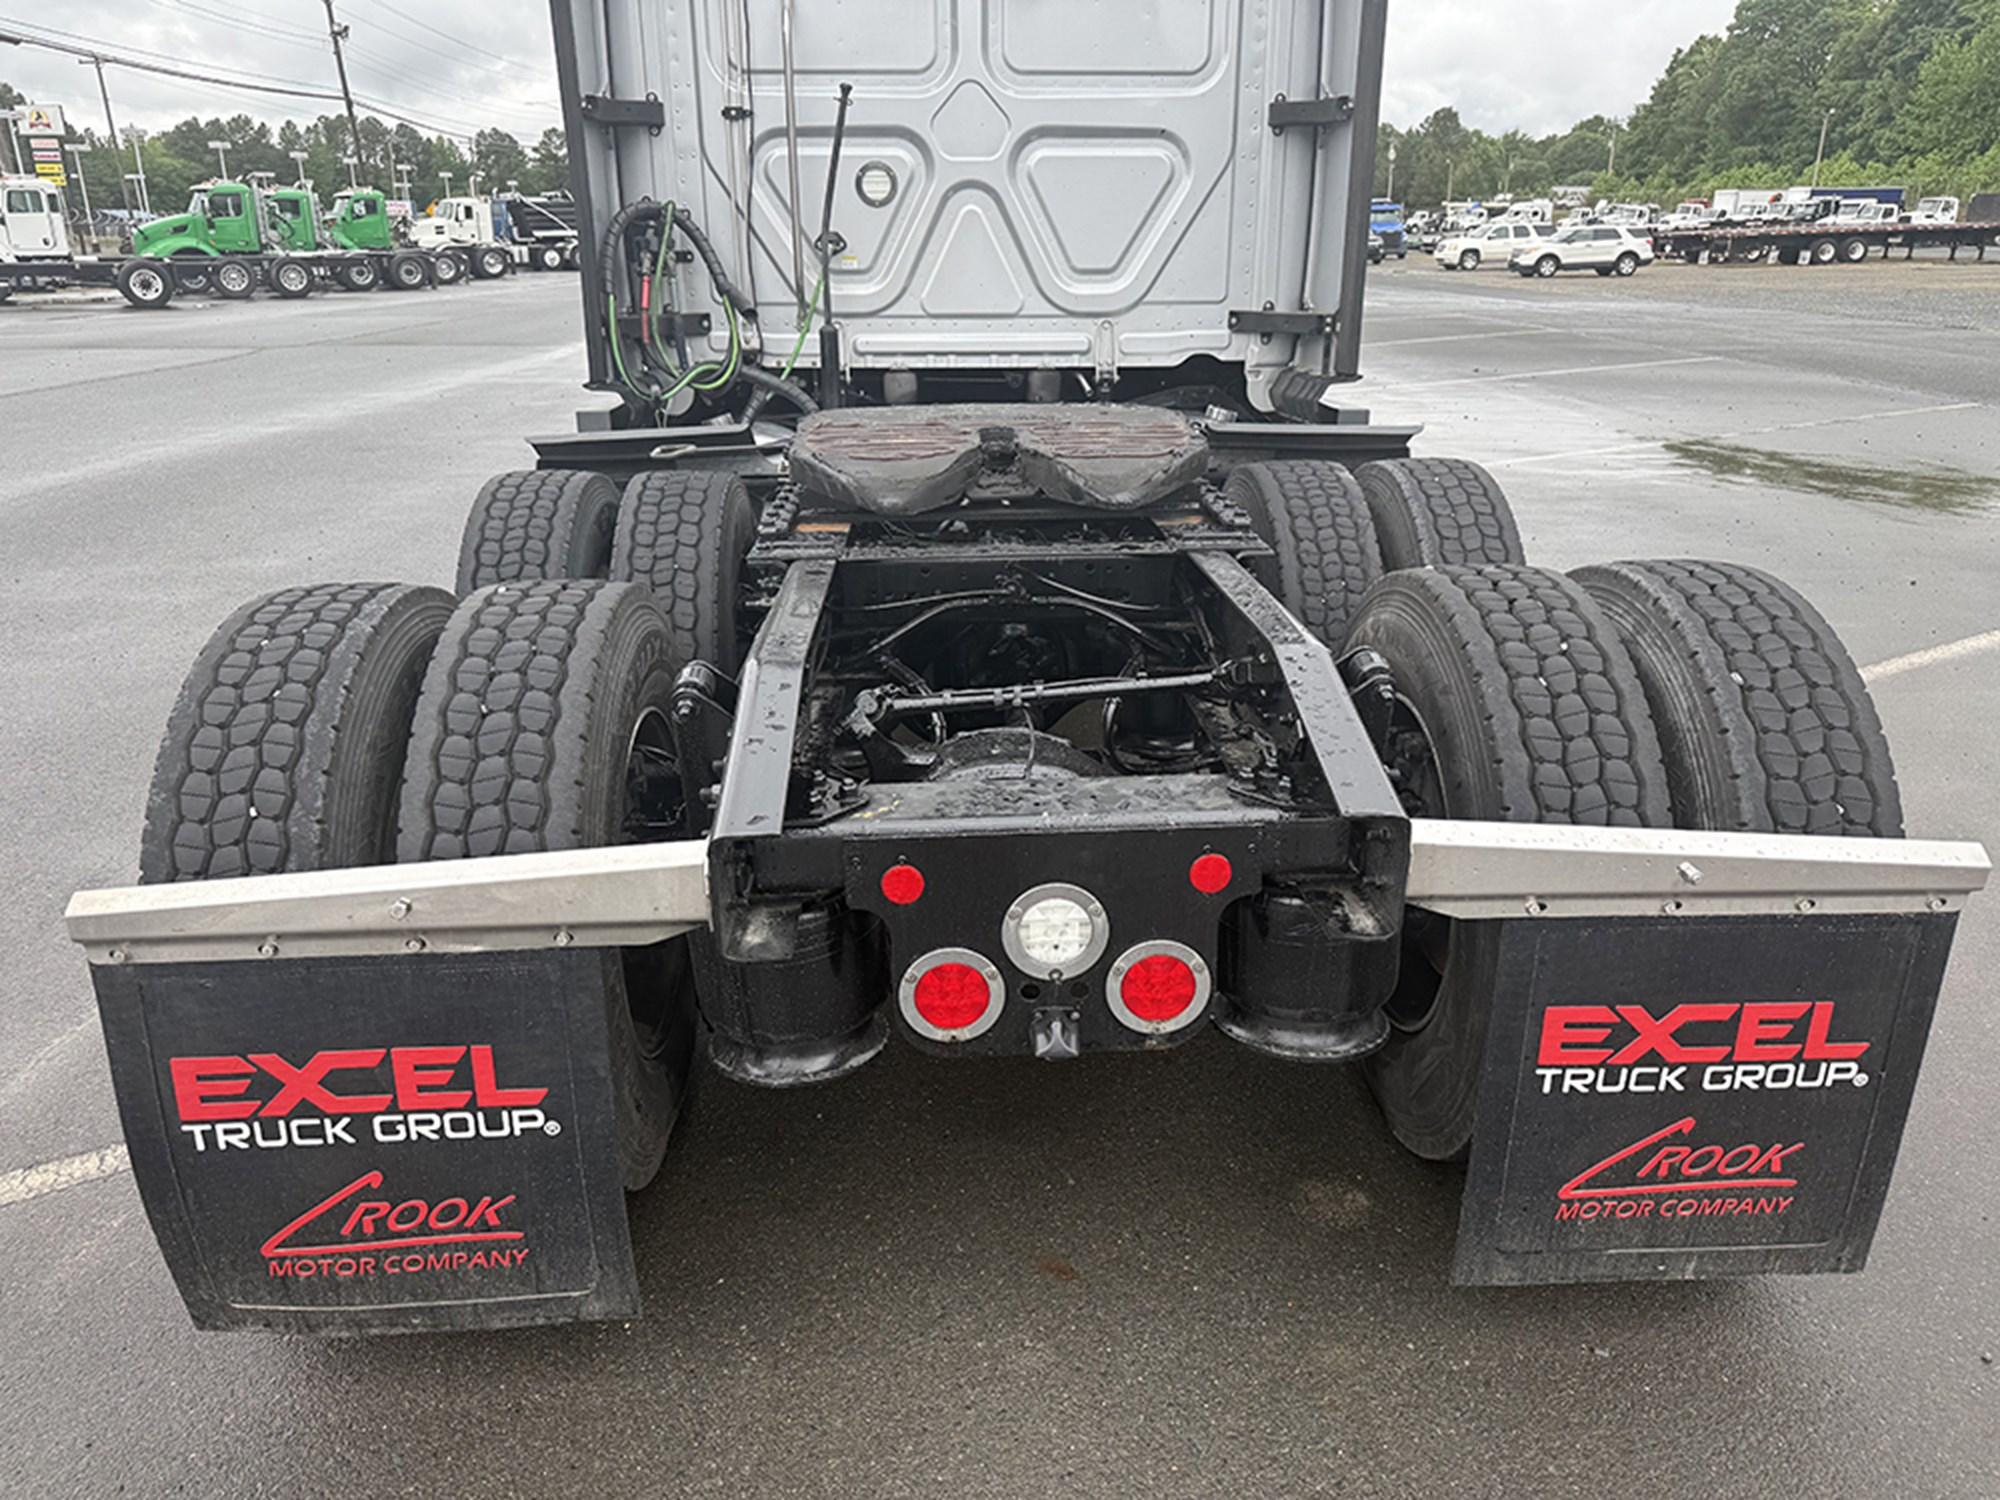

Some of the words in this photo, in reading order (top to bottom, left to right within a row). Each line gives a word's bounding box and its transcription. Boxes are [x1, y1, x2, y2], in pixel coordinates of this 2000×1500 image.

[1537, 1001, 1870, 1065] EXCEL
[169, 1045, 549, 1121] EXCEL
[1535, 1066, 1686, 1094] TRUCK
[181, 1117, 356, 1152] TRUCK
[1554, 1200, 1653, 1221] MOTOR
[1658, 1196, 1794, 1218] COMPANY
[268, 1257, 376, 1279] MOTOR
[383, 1249, 529, 1275] COMPANY
